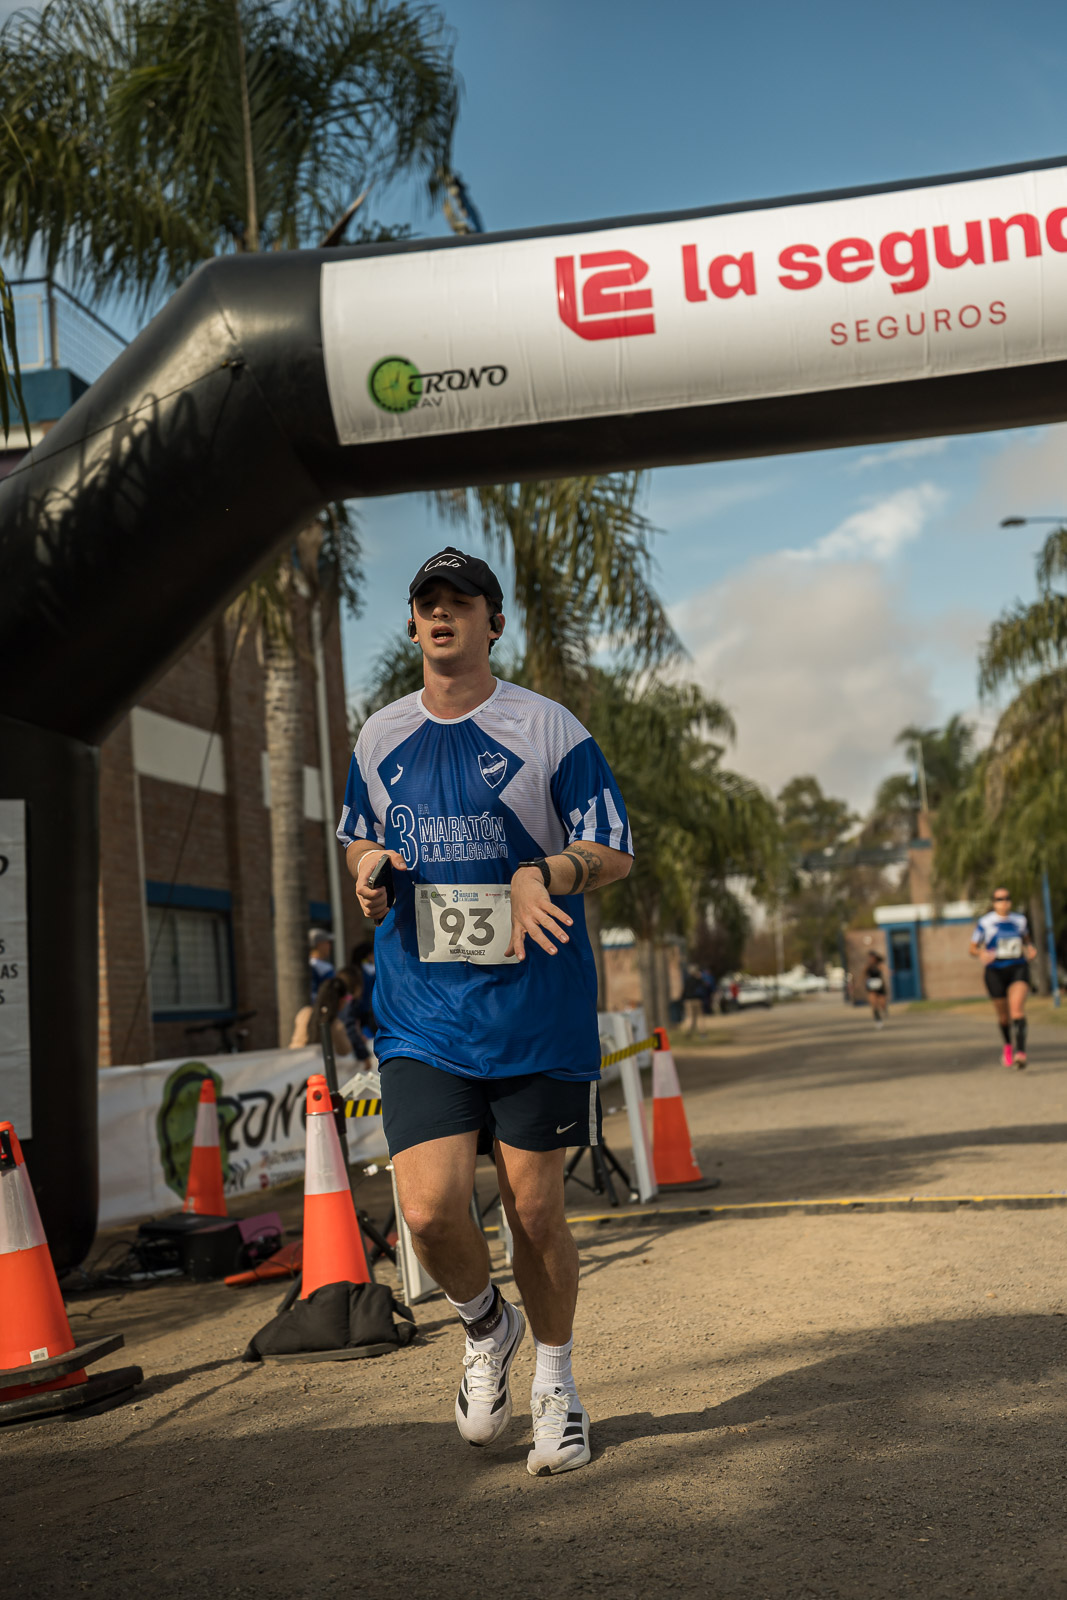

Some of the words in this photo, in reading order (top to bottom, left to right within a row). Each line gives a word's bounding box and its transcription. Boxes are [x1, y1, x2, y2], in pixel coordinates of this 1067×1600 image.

[682, 243, 757, 303] la
[830, 301, 1007, 346] SEGUROS
[407, 364, 508, 396] CRONO
[408, 396, 443, 409] RAV
[390, 804, 418, 871] 3
[418, 811, 506, 843] MARATÓN
[452, 889, 459, 903] 3
[439, 907, 495, 946] 93
